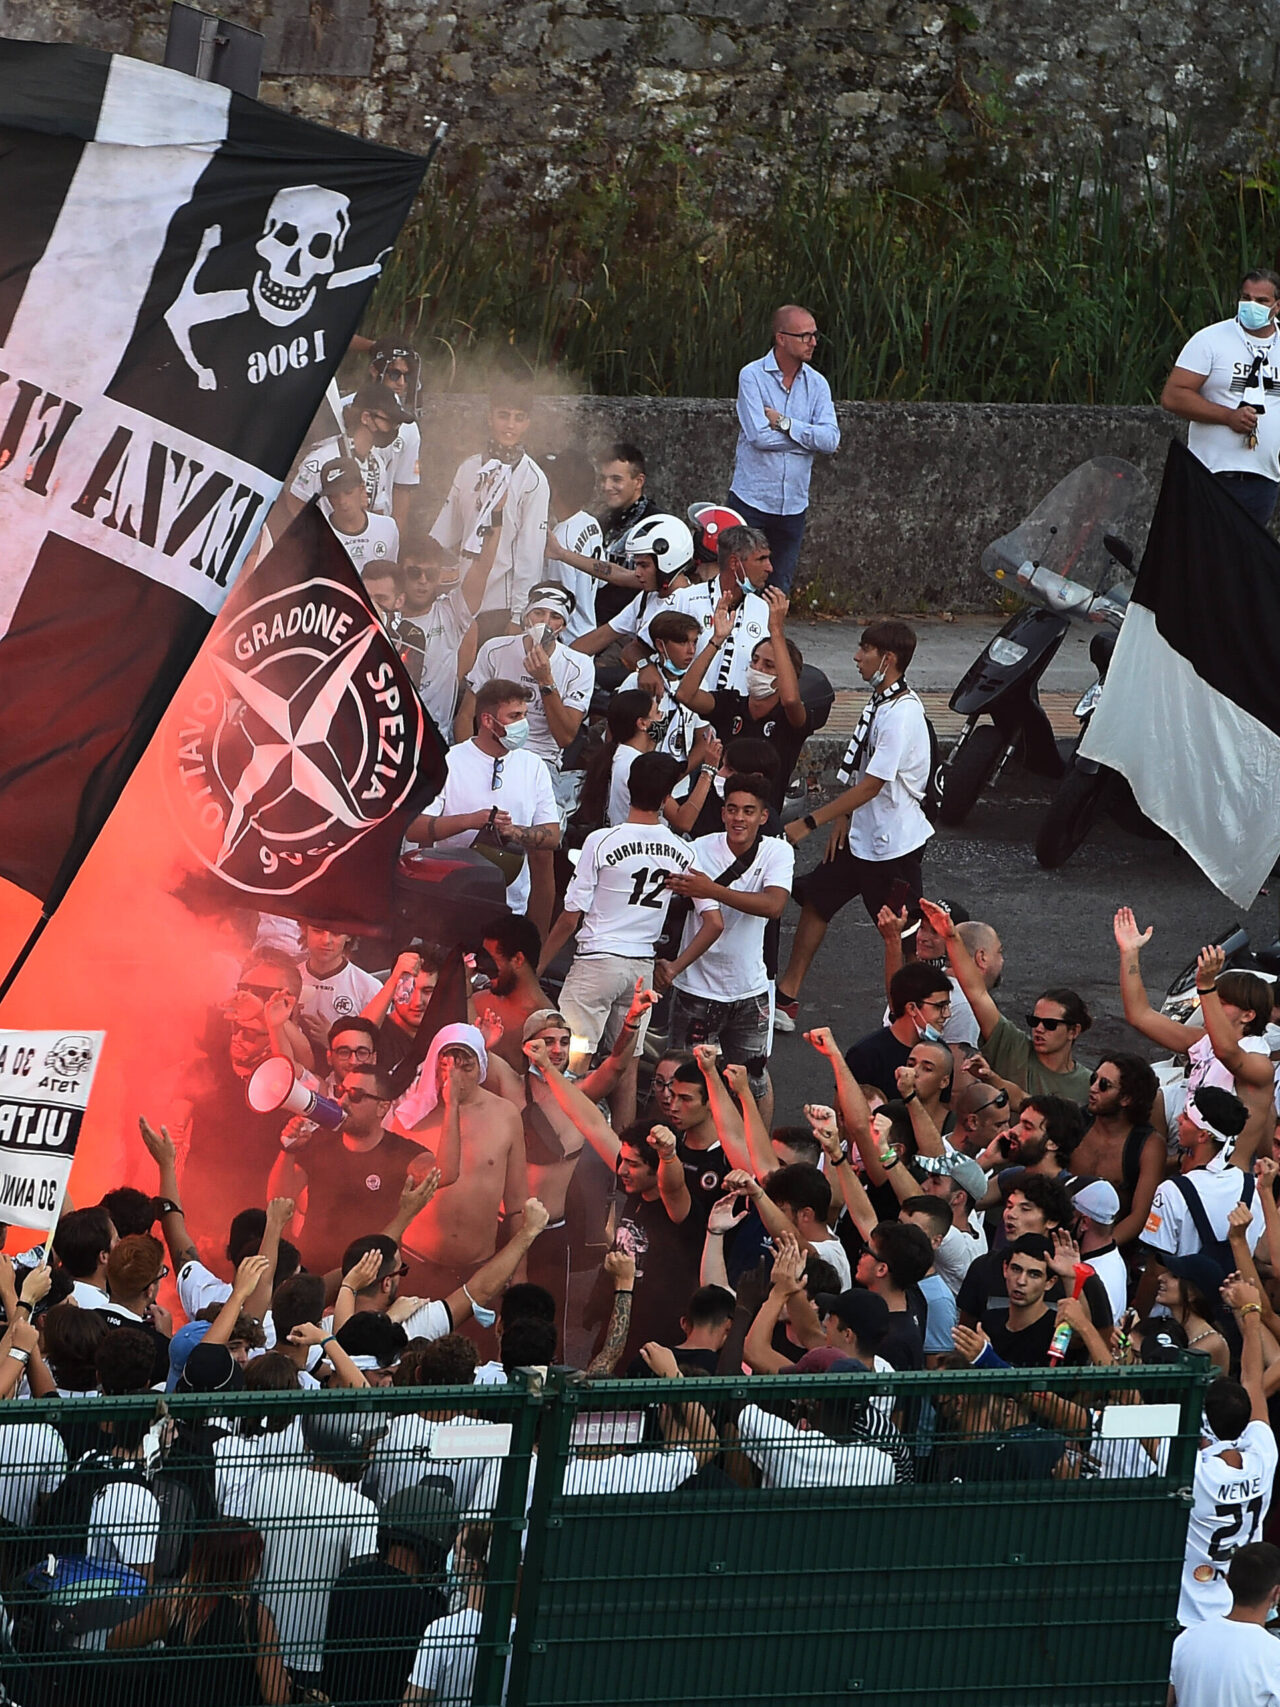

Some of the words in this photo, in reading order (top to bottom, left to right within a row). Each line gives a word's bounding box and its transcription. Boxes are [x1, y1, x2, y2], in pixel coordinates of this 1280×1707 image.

[234, 602, 354, 661] GRADONE
[361, 661, 405, 800] SPEZIA
[605, 842, 644, 866] CURVA
[645, 842, 690, 873] FERROVIA
[628, 866, 673, 910] 12
[1218, 1477, 1261, 1501] NENE
[1208, 1495, 1263, 1562] 21
